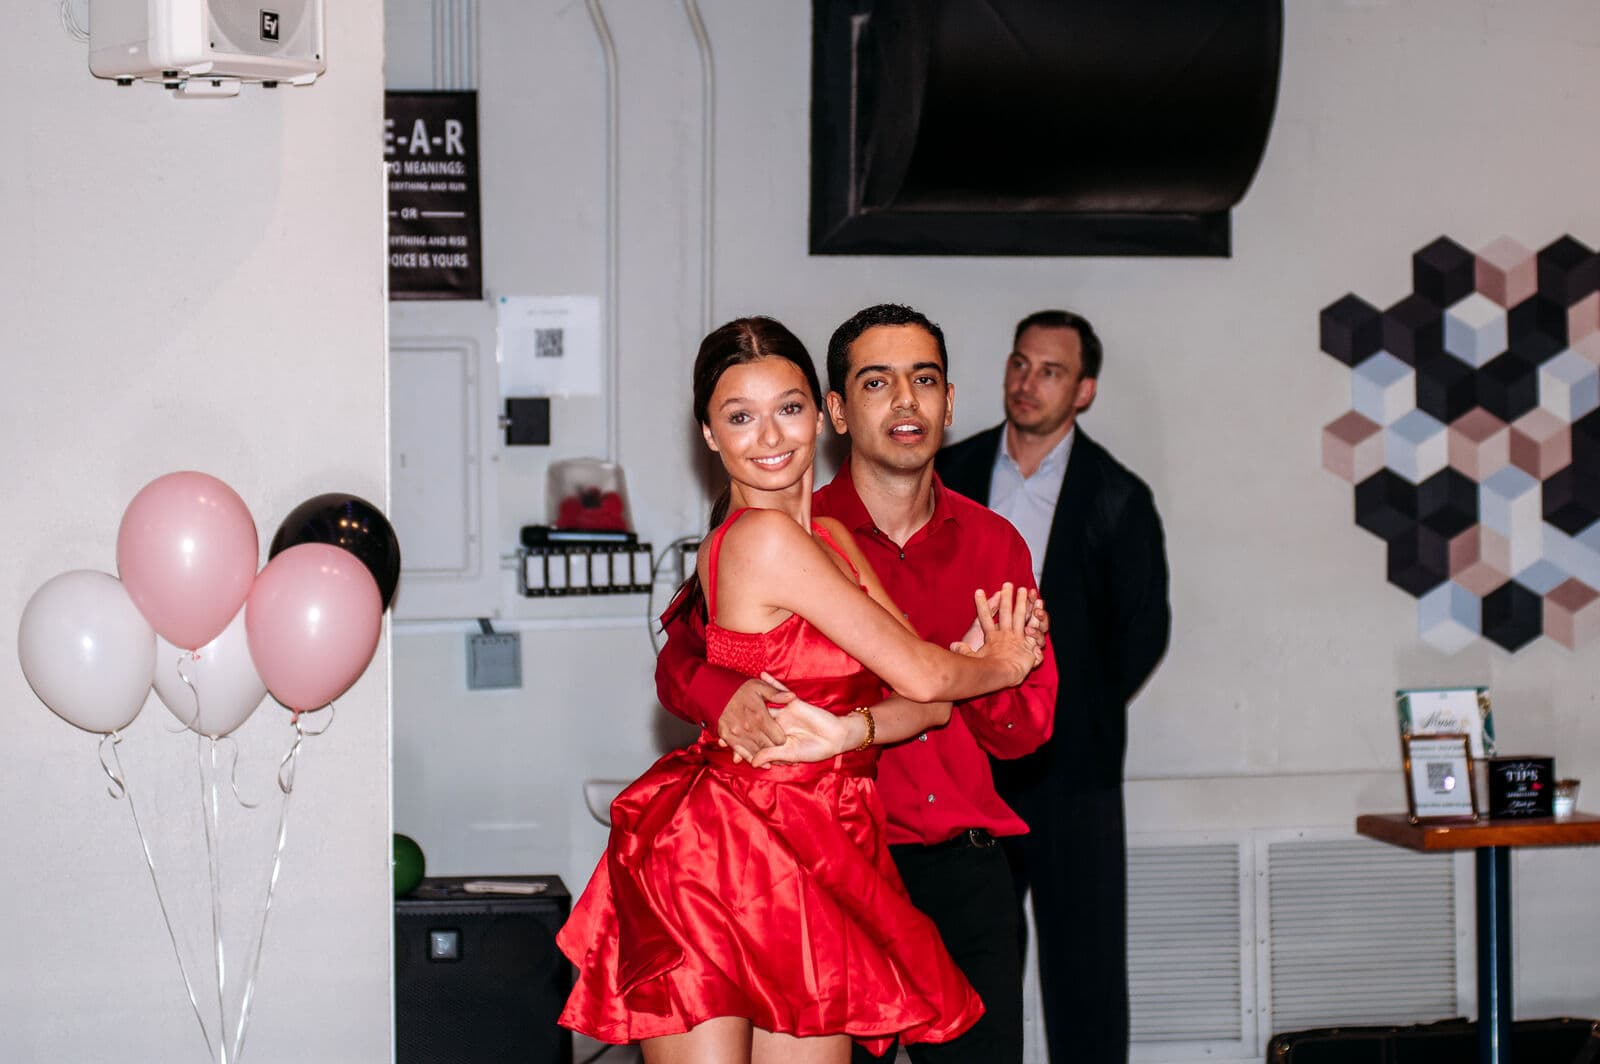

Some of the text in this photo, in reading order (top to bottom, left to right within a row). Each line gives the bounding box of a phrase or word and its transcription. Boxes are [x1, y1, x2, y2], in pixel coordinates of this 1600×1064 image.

[404, 161, 464, 175] MEANINGS:
[400, 207, 417, 219] OR
[428, 235, 447, 246] AND
[419, 253, 429, 267] IS
[431, 253, 468, 267] YOURS
[1506, 770, 1538, 782] TIPS
